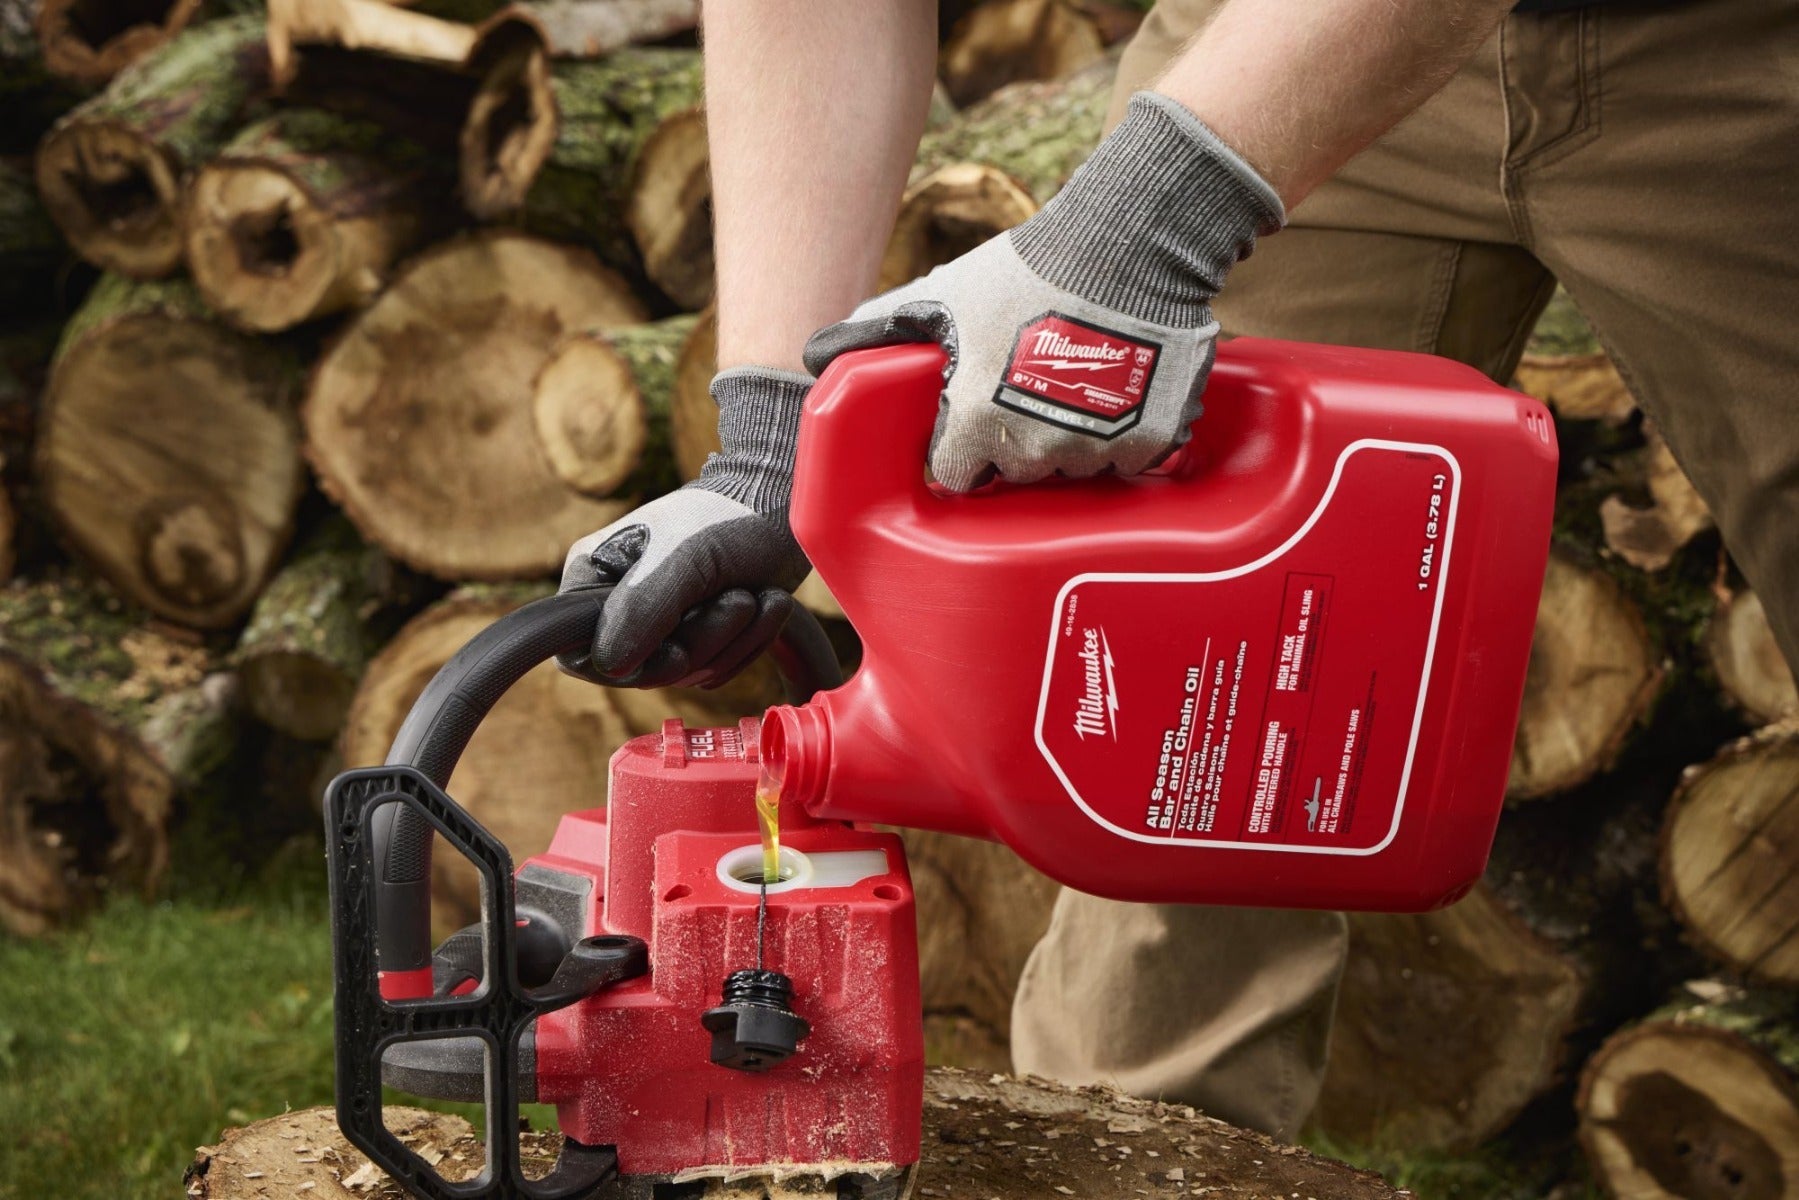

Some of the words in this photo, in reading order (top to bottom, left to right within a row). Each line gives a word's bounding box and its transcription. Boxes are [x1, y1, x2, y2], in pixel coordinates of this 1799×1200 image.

[1020, 399, 1045, 412] CUT
[1048, 408, 1083, 425] LEVEL
[1086, 420, 1094, 428] 4
[1433, 475, 1445, 490] L)
[1426, 495, 1440, 539] (3.78
[1420, 544, 1433, 578] GAL
[1301, 590, 1313, 615] SLING
[1299, 618, 1308, 631] OIL
[1281, 635, 1295, 662] TACK
[1292, 634, 1306, 672] MINIMAL
[1073, 628, 1106, 741] Milwaukee
[1185, 667, 1199, 692] Oil
[1227, 641, 1248, 716] guide-chaîne
[1276, 665, 1290, 690] HIGH
[1288, 674, 1298, 691] FOR
[1174, 698, 1194, 751] Chain
[1225, 719, 1233, 731] et
[1349, 709, 1360, 732] SAWS
[692, 730, 714, 757] FUEL
[1217, 734, 1230, 772] chaîne
[1274, 733, 1288, 766] HANDLE
[1344, 734, 1355, 753] POLE
[1151, 730, 1174, 801] Season
[1169, 756, 1183, 791] and
[1186, 796, 1200, 831] Aceite
[1193, 778, 1202, 792] de
[1198, 732, 1212, 775] cadena
[1207, 688, 1220, 720] barra
[1341, 755, 1351, 771] AND
[1178, 803, 1190, 830] Toda
[1184, 752, 1199, 800] Estación
[1197, 794, 1211, 831] Quatre
[1205, 745, 1220, 790] Saisons
[1212, 775, 1223, 801] pour
[1248, 769, 1270, 833] CONTROLLED
[1262, 721, 1280, 766] POURING
[1265, 768, 1280, 811] CENTERED
[1331, 773, 1347, 817] CHAINSAWS
[1146, 806, 1160, 829] All
[1159, 796, 1176, 829] Bar
[1205, 804, 1217, 832] Huile
[1260, 813, 1271, 833] WITH
[1319, 820, 1328, 833] FOR
[1321, 807, 1330, 819] USE
[1328, 819, 1338, 833] ALL
